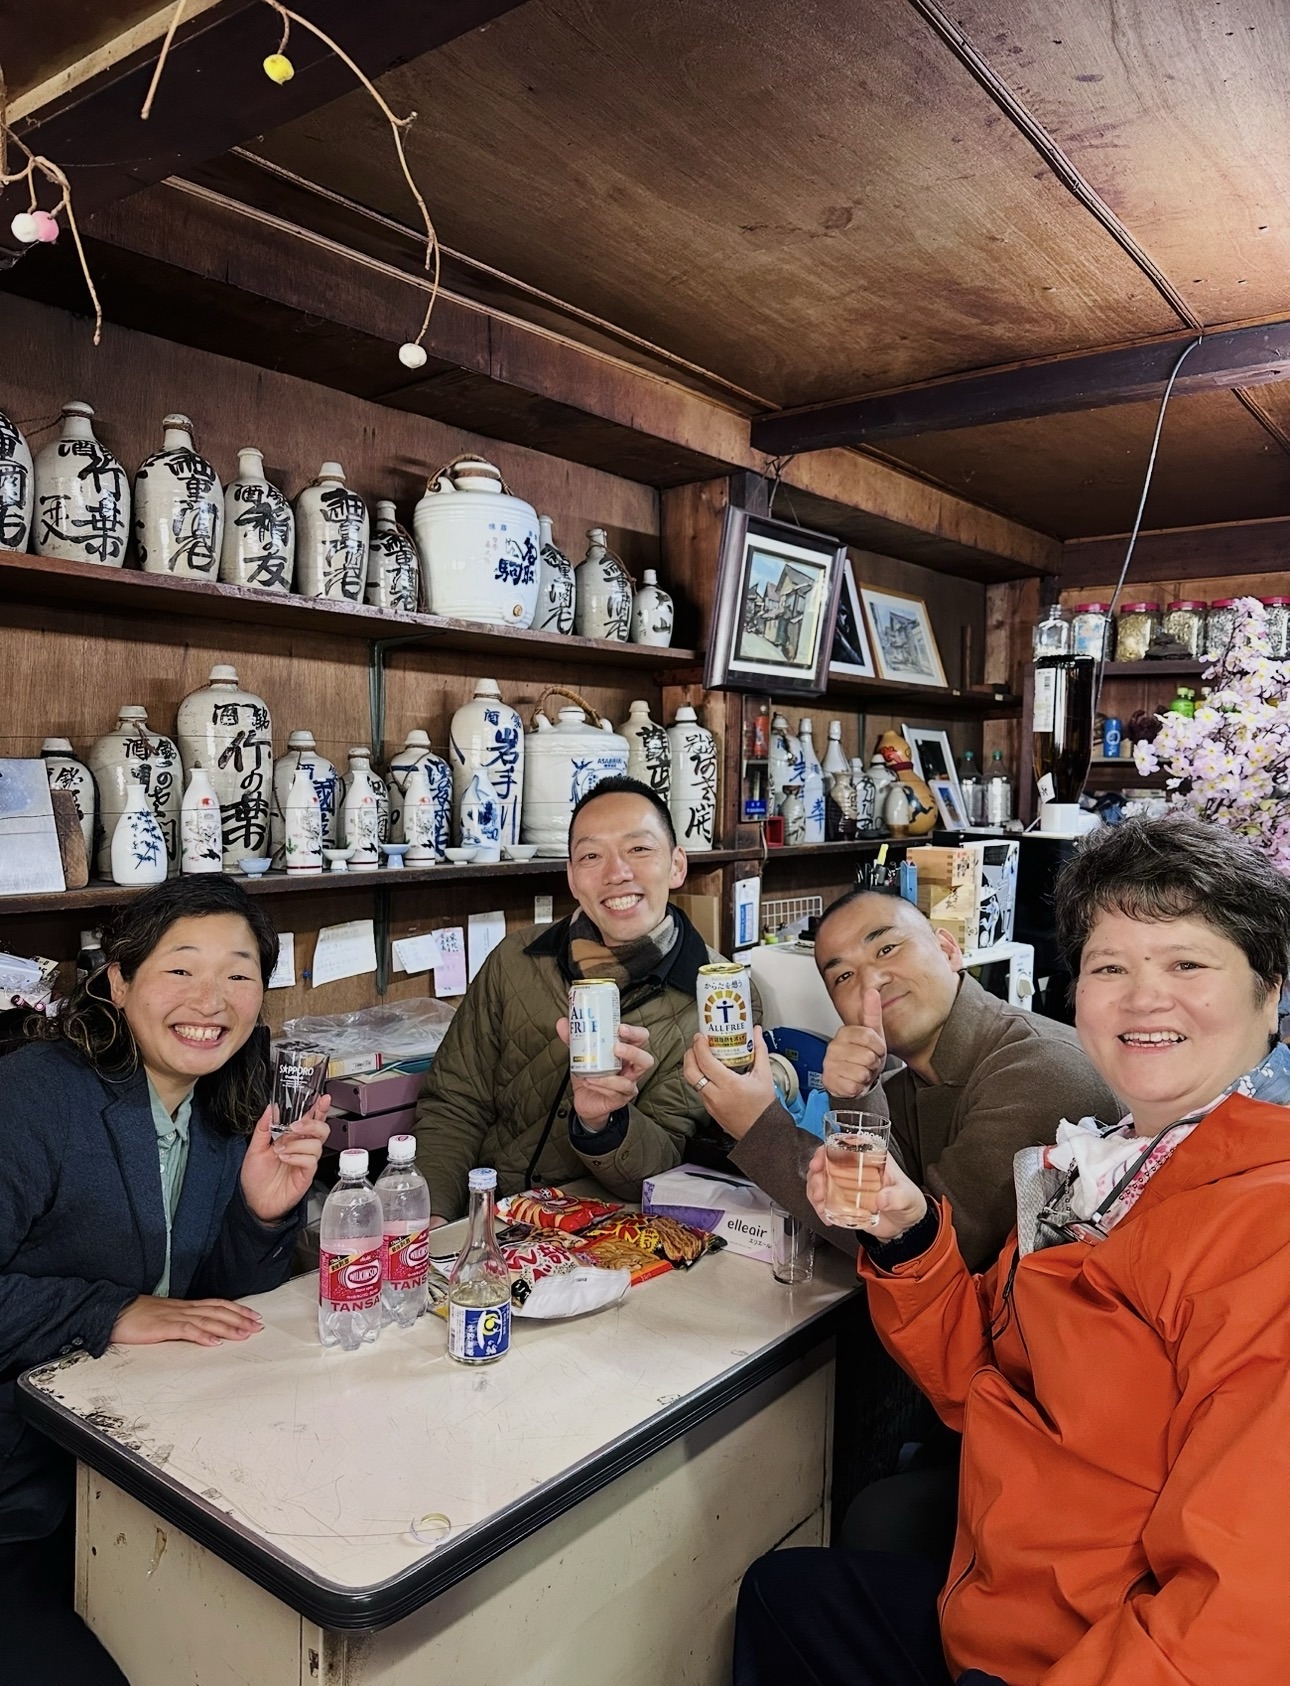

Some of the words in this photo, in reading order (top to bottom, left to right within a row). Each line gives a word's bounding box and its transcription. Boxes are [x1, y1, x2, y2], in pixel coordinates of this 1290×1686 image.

[481, 728, 520, 845] 岩手川
[727, 1218, 768, 1238] elleair
